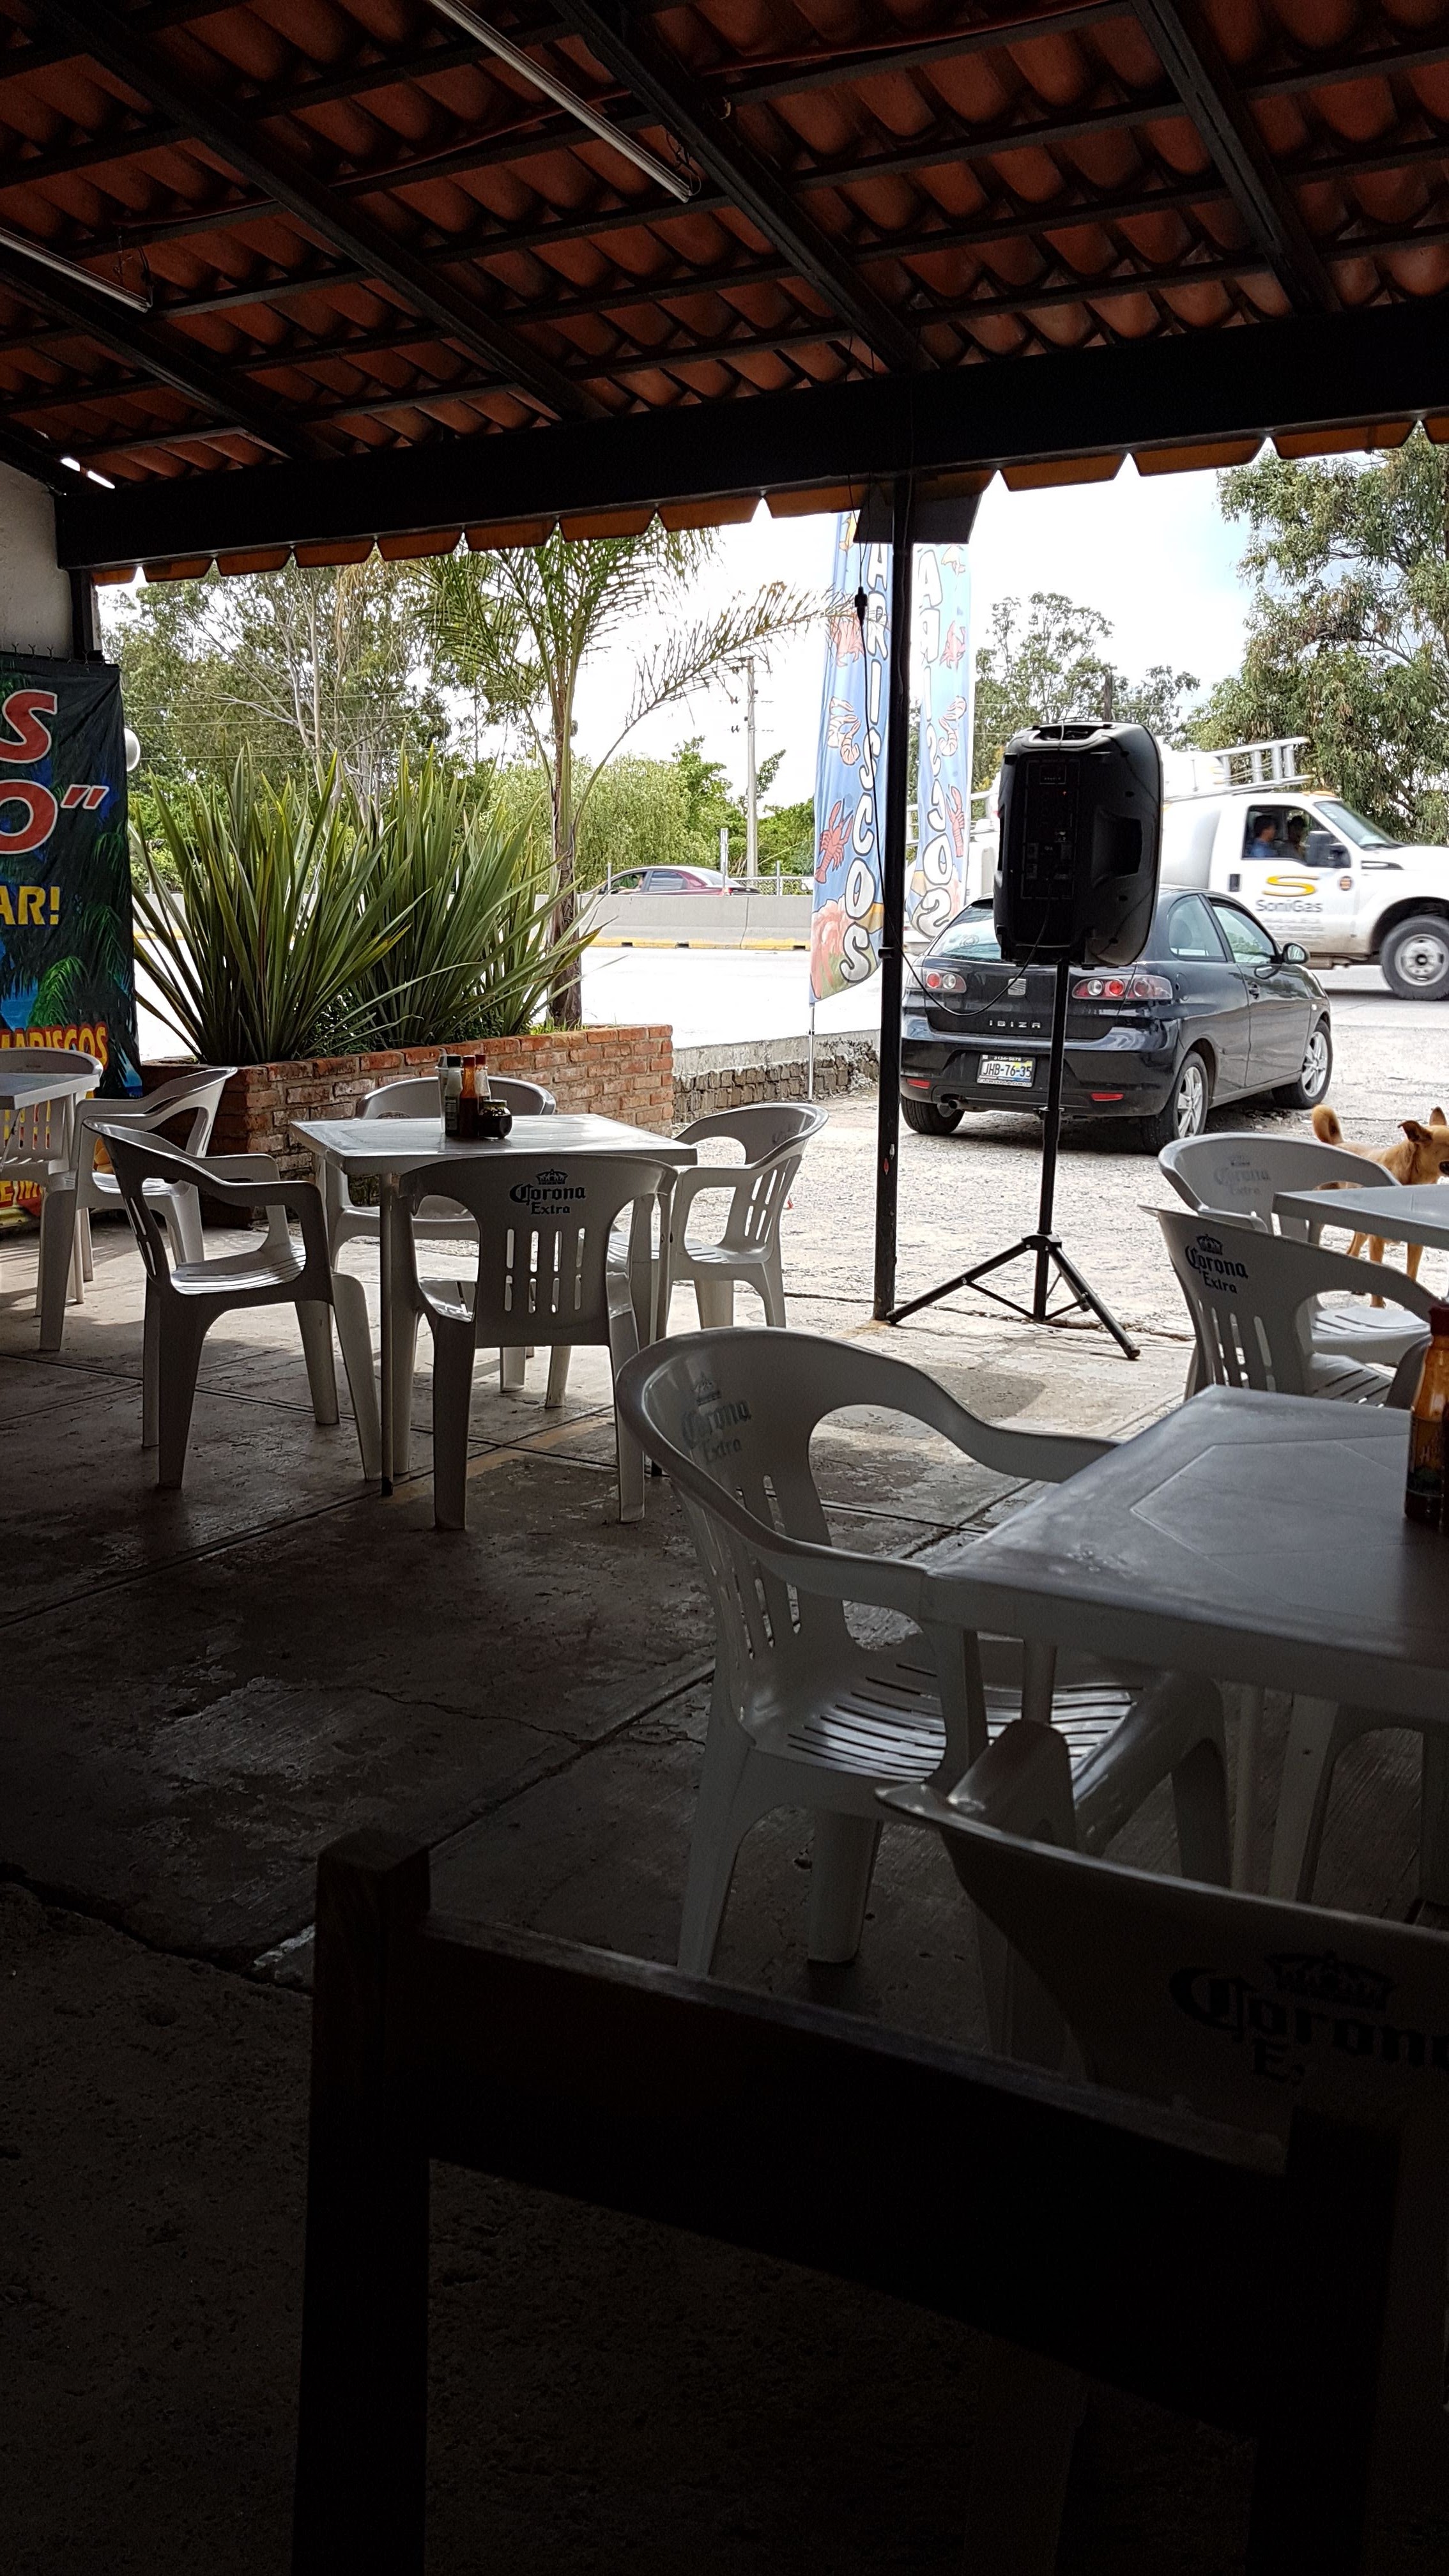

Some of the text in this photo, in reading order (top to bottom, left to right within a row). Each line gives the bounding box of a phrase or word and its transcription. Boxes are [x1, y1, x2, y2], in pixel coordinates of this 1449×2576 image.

[839, 543, 889, 985] ARISCOS
[1255, 899, 1323, 913] SoniGas
[989, 1020, 1041, 1029] IBIZA
[983, 1062, 1032, 1078] JHB-76-35
[509, 1183, 586, 1206] Corona
[531, 1202, 571, 1215] Extra
[1185, 1245, 1248, 1279] Corona
[1204, 1270, 1238, 1294] Extra
